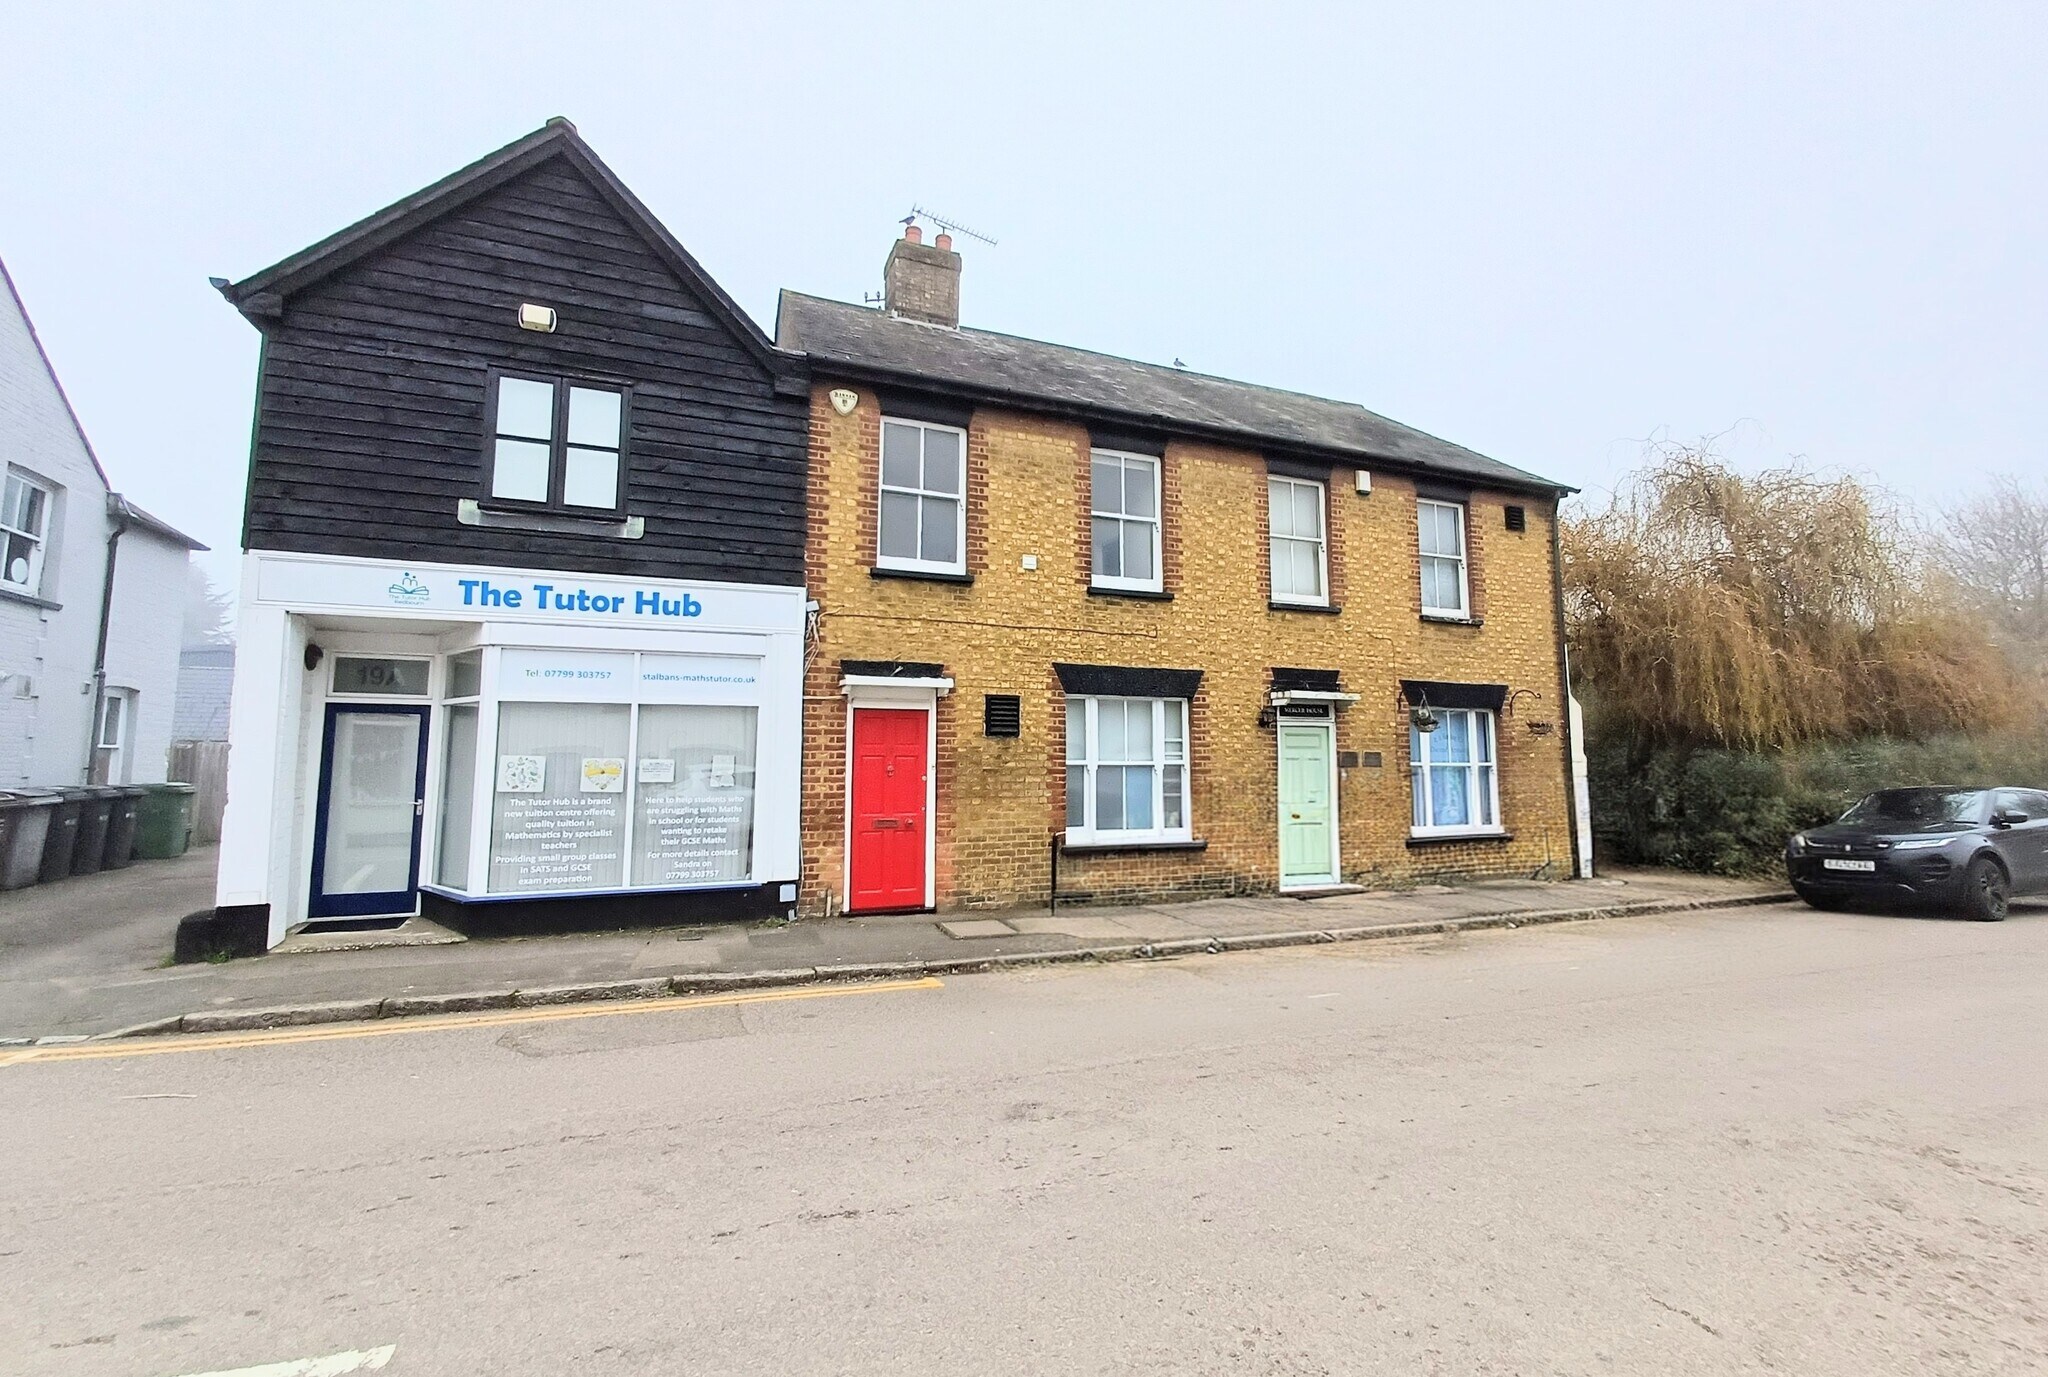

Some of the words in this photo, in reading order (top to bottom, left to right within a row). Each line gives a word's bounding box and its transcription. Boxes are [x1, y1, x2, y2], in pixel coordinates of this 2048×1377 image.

[458, 580, 522, 607] The
[534, 585, 624, 612] Tutor
[635, 591, 701, 617] Hub
[643, 673, 756, 683] stalbans-mathstutor.co.uk
[584, 808, 615, 816] offering
[526, 820, 555, 829] quality
[505, 831, 560, 840] Mathematics
[563, 830, 573, 839] by
[575, 830, 612, 838] specialist
[544, 875, 592, 885] preparation
